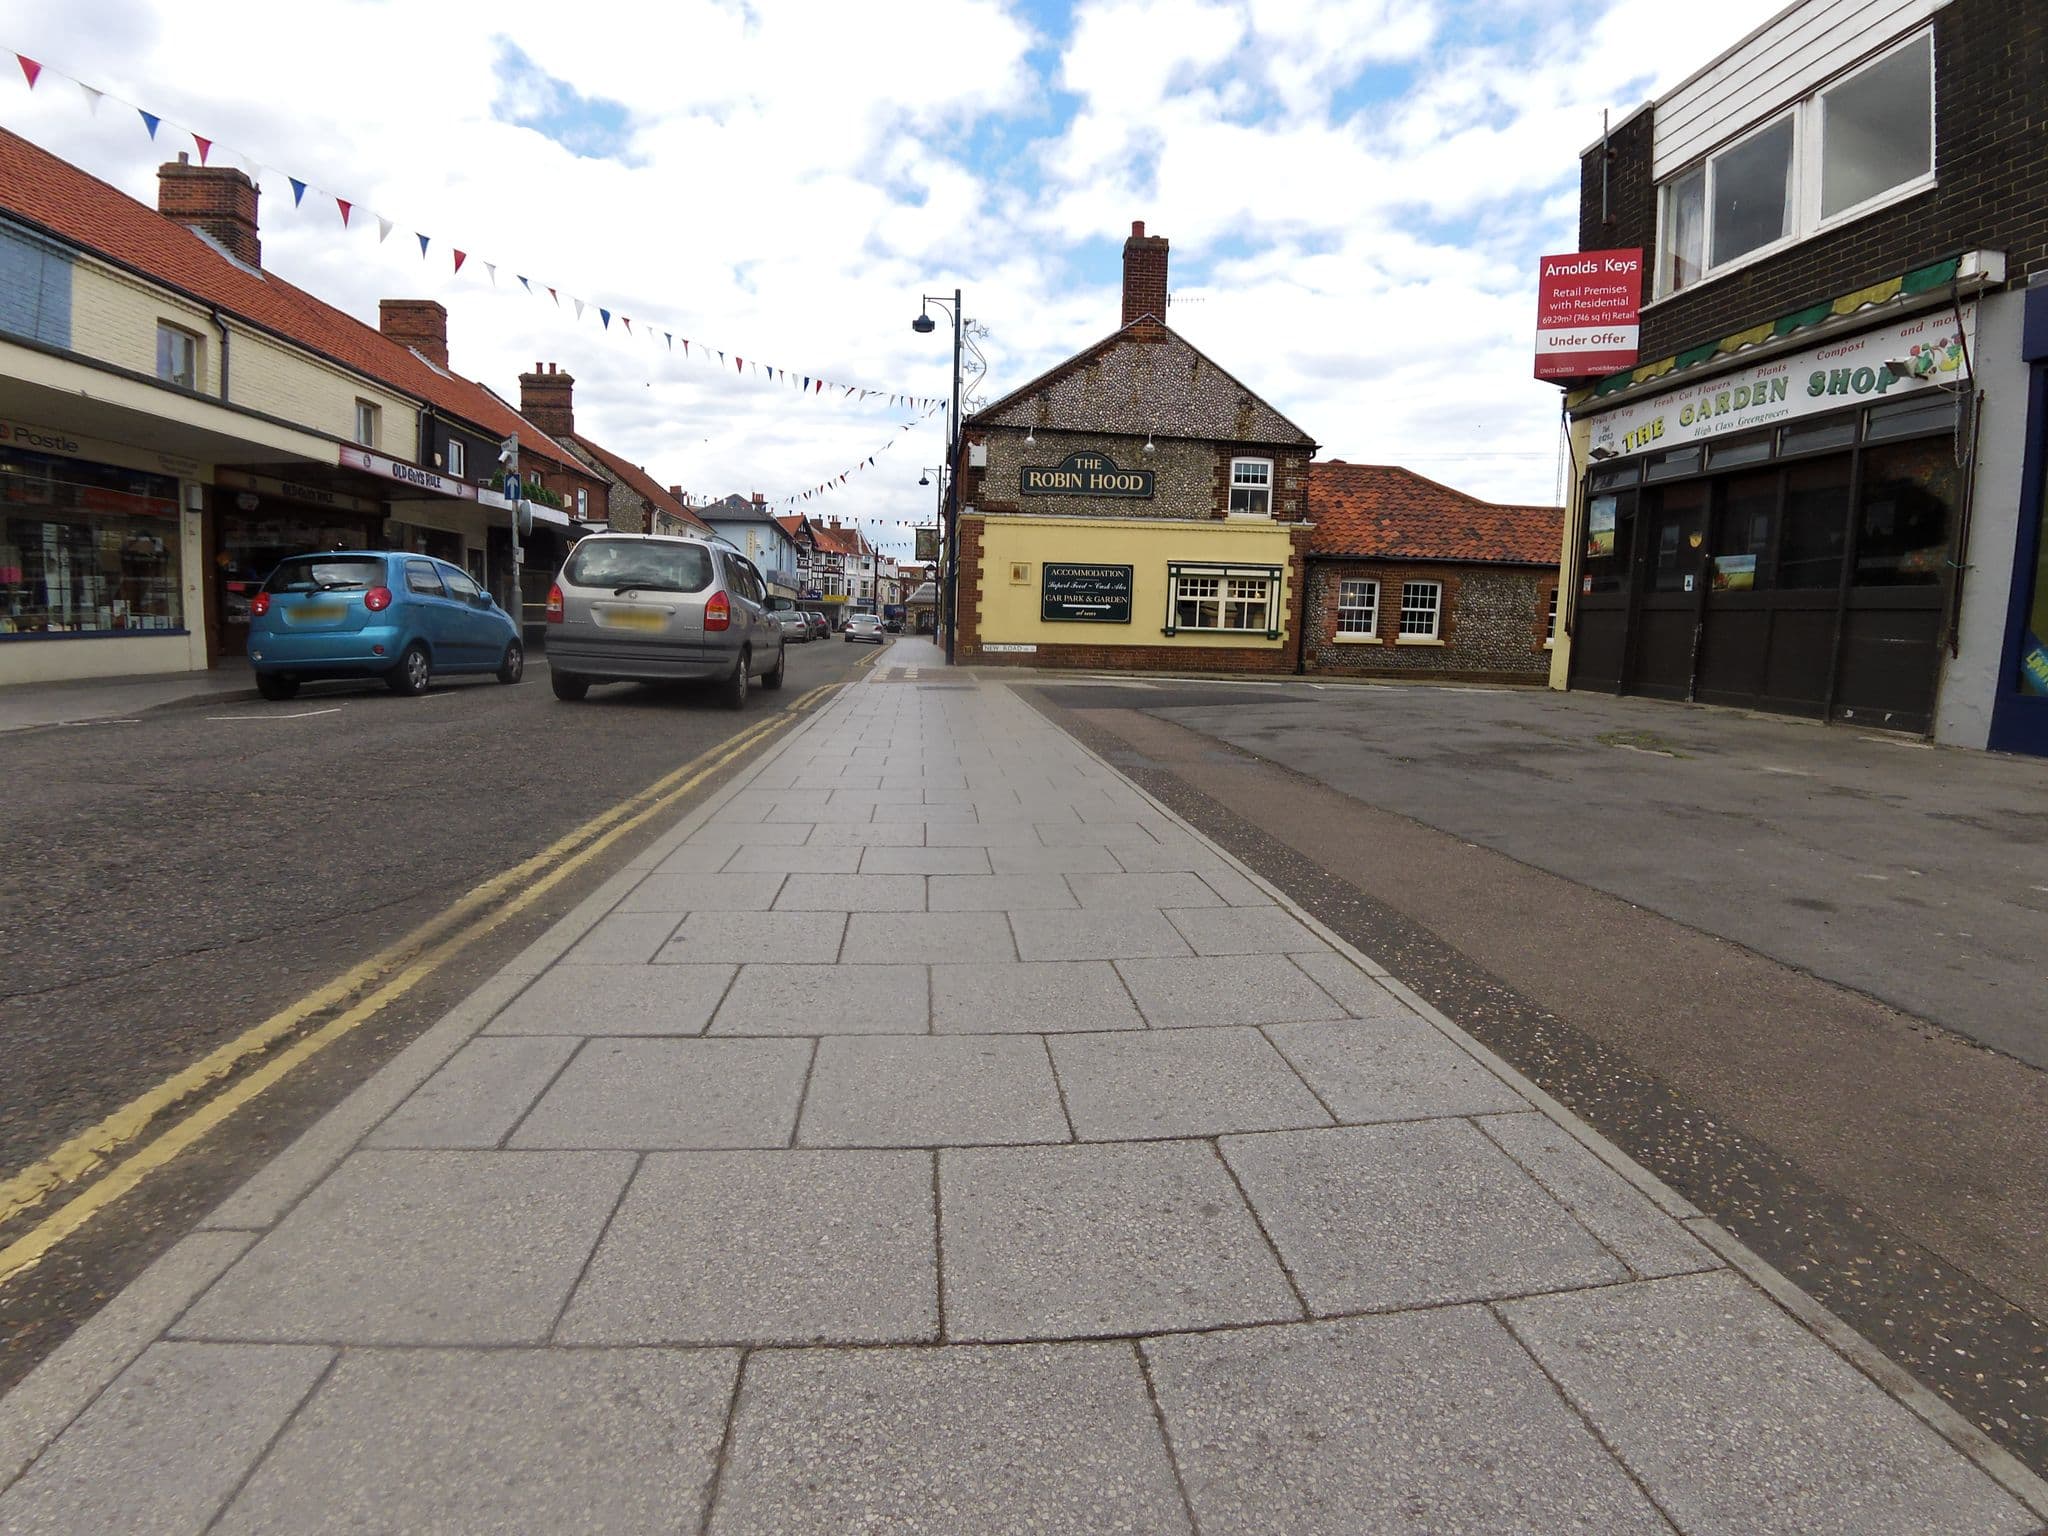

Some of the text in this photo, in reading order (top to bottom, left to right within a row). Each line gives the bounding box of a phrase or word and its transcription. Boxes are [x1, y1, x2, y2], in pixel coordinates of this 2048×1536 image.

[1545, 258, 1637, 277] Arnolds Keys
[1553, 285, 1627, 298] Retail Premises
[1550, 296, 1629, 311] with Residential
[1573, 312, 1590, 323] (746
[1591, 314, 1600, 322] sq
[1602, 312, 1611, 321] ft)
[1612, 311, 1635, 319] Retail
[1549, 332, 1626, 346] Under Offer
[1653, 396, 1674, 409] Fresh
[1679, 391, 1692, 401] Cut
[1698, 381, 1731, 396] Flowers
[1757, 363, 1787, 378] Plants
[1816, 340, 1865, 361] Compost
[1900, 321, 1925, 338] and
[1932, 307, 1971, 328] mor!
[1622, 366, 1899, 453] THE GARDEN SHOP
[1694, 407, 1790, 437] High Class Greengrocers
[13, 426, 79, 453] Postle
[1074, 458, 1103, 470] THE
[392, 462, 442, 489] OLD GUYS RULE
[1029, 471, 1144, 491] ROBIN HOOD
[1051, 568, 1125, 578] ACCOMMODATION
[1045, 594, 1063, 602] CAR
[1063, 594, 1085, 602] PARK
[1093, 595, 1128, 603] GARDEN
